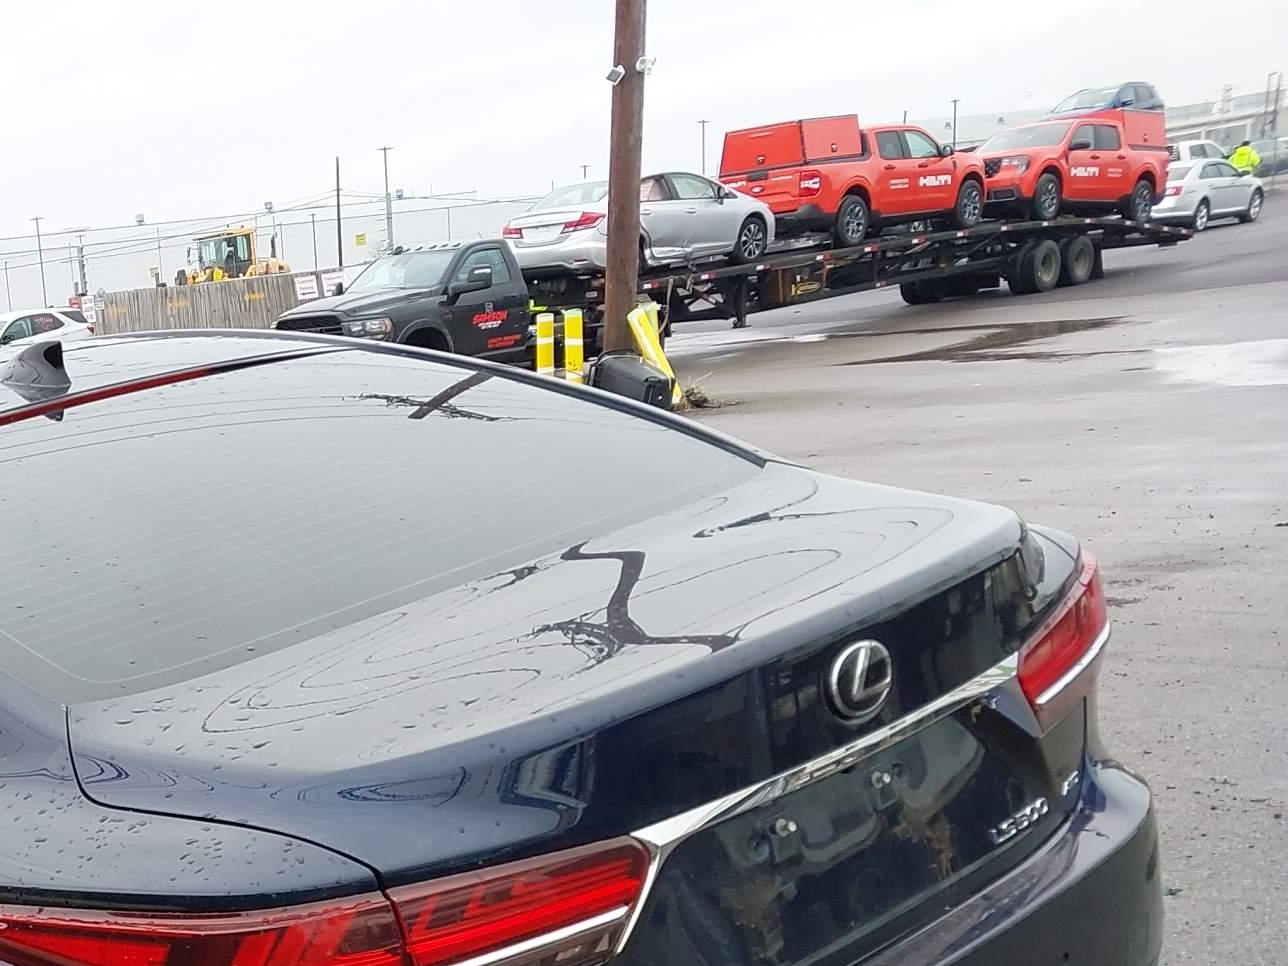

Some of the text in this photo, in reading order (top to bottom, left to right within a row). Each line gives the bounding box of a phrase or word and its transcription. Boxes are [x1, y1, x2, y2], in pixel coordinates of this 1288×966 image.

[1070, 166, 1100, 177] HILTI
[919, 174, 952, 187] HILTI
[472, 309, 508, 325] SAMSON
